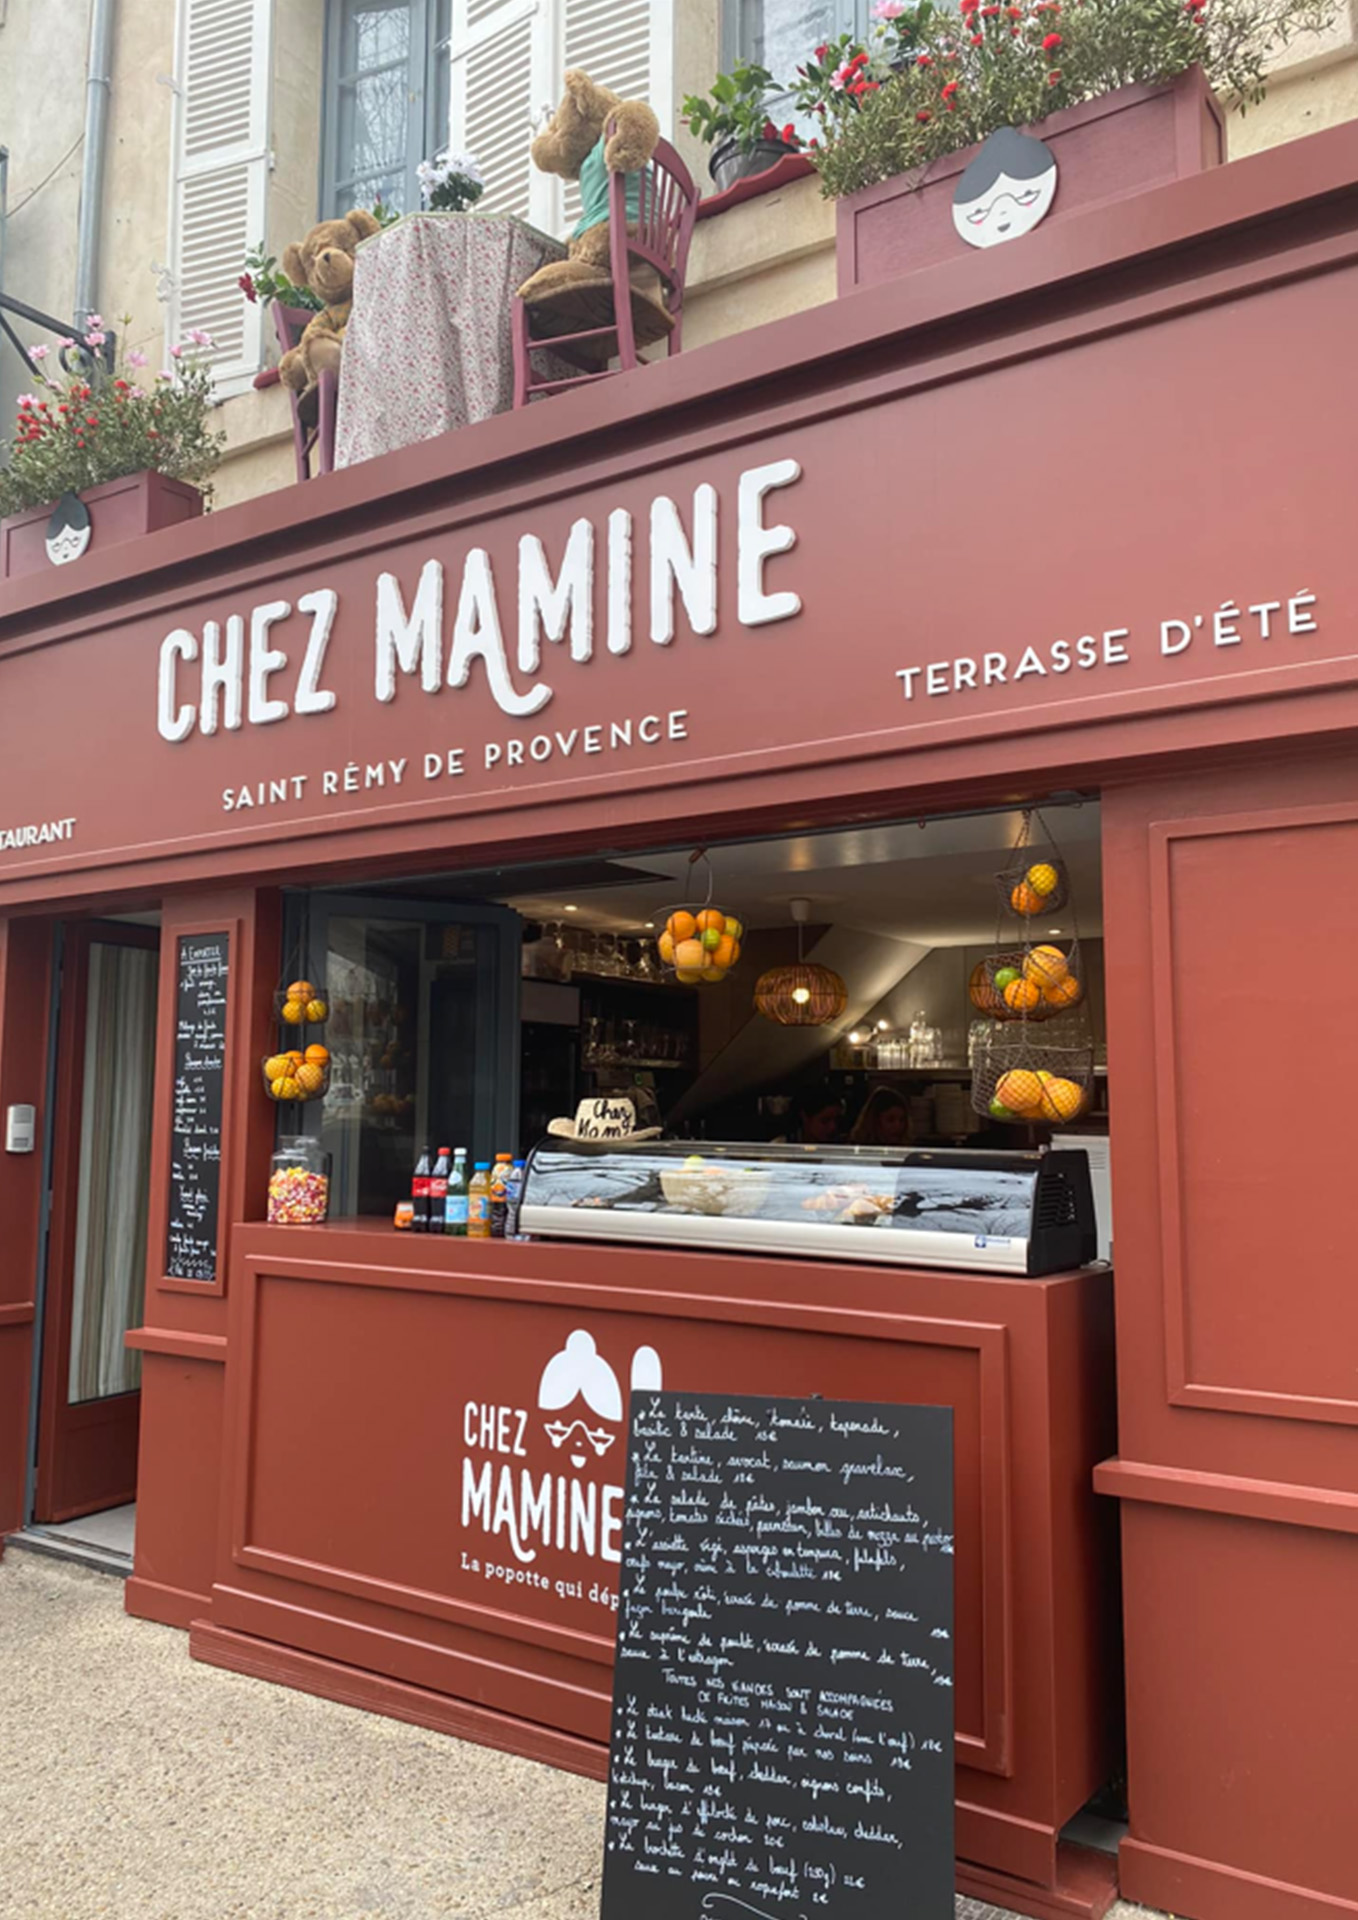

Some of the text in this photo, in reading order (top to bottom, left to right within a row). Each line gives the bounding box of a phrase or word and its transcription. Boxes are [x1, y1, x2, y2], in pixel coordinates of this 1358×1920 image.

[157, 458, 801, 743] CHEZ MAMINE
[895, 588, 1318, 700] TERRASSE D'ÉTÉ
[222, 710, 688, 811] SAINT RÉMY DE PROVENCE
[464, 1401, 528, 1456] CHEZ
[694, 1422, 737, 1441] salade
[681, 1465, 723, 1484] salade
[782, 1458, 831, 1473] saumon
[671, 1488, 710, 1506] salade
[720, 1490, 737, 1510] de
[461, 1457, 625, 1563] MAMINE
[848, 1524, 863, 1540] de
[746, 1555, 759, 1574] la
[461, 1552, 480, 1572] La
[485, 1561, 550, 1590] popotte
[555, 1580, 583, 1599] qui
[761, 1594, 778, 1609] de
[826, 1600, 843, 1615] de
[698, 1633, 713, 1647] de
[805, 1641, 822, 1657] de
[877, 1648, 895, 1665] de
[690, 1731, 703, 1746] de
[686, 1758, 700, 1773] de
[744, 1807, 758, 1824] de
[692, 1823, 705, 1837] de
[745, 1857, 759, 1872] de
